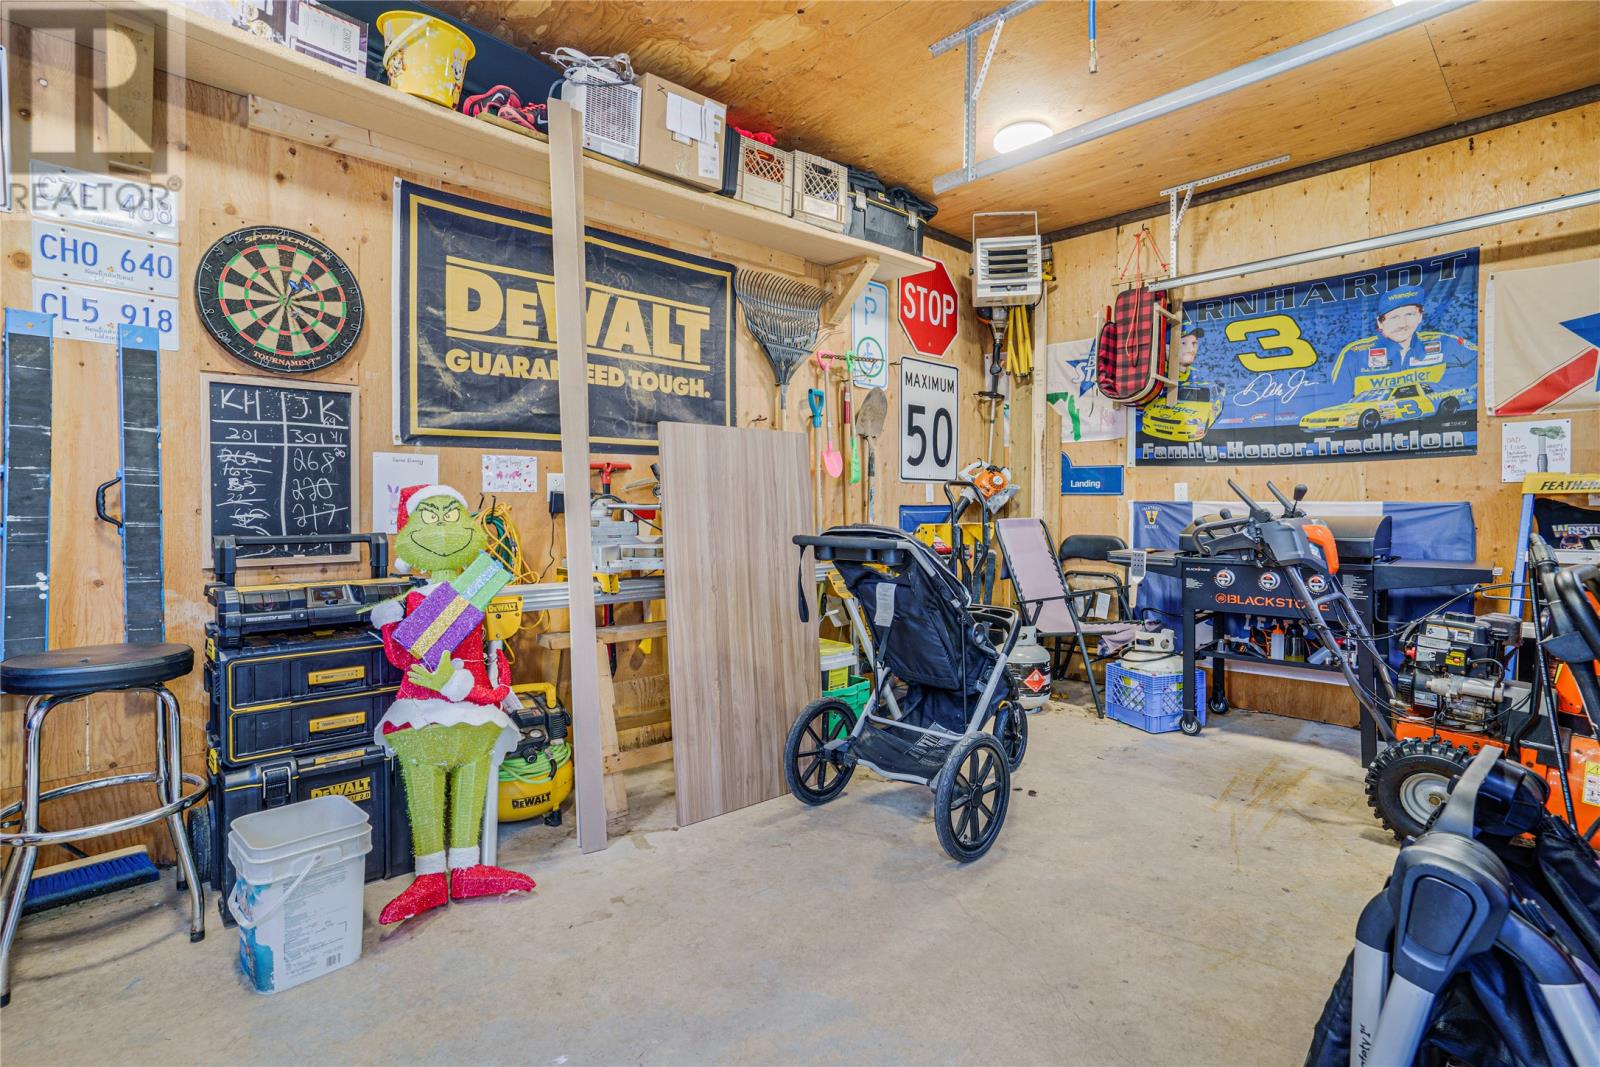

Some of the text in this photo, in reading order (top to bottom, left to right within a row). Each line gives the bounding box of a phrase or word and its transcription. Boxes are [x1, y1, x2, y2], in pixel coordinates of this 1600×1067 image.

[121, 249, 172, 278] 640
[121, 304, 173, 333] 918
[903, 282, 955, 328] STOP
[1225, 314, 1318, 373] 3
[445, 349, 710, 398] GUARAEED TOUGH.
[905, 371, 955, 394] MAXIMUM
[1396, 399, 1423, 419] 3
[907, 404, 952, 468] 50
[1070, 480, 1101, 489] Landing
[511, 793, 551, 809] DEWALT
